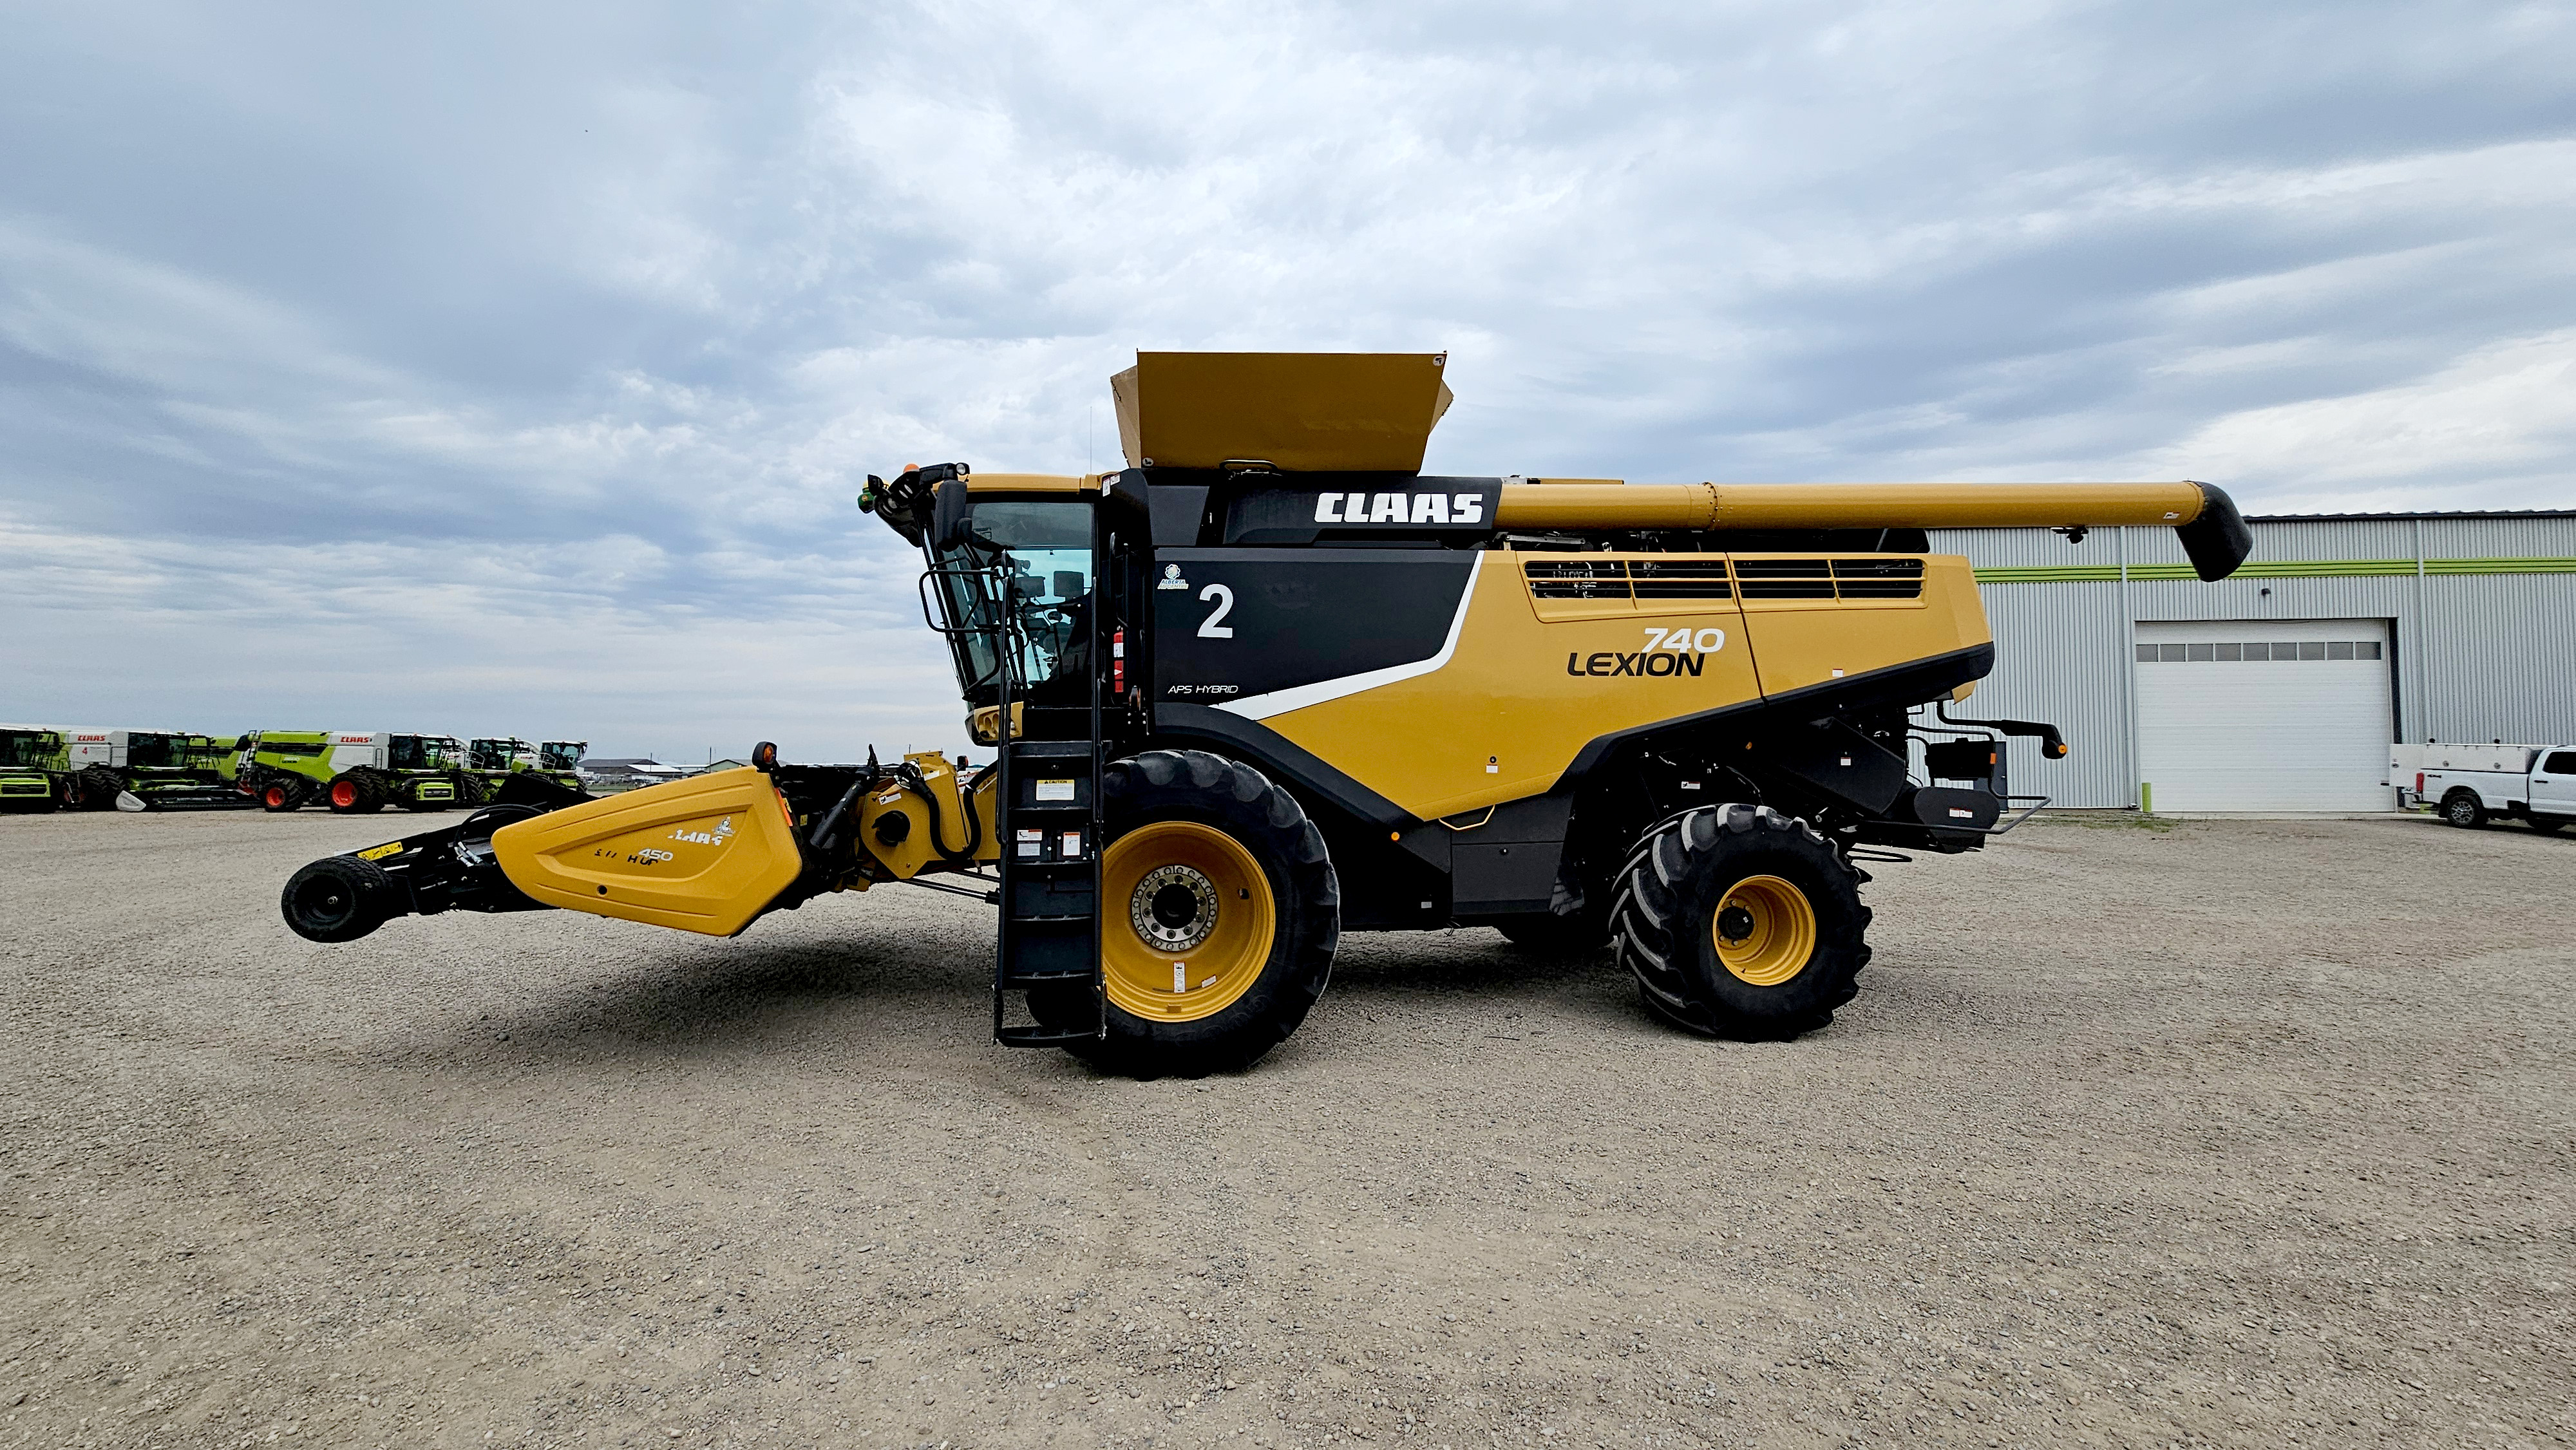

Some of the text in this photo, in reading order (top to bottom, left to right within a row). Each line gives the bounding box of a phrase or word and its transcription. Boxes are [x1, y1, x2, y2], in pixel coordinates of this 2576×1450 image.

[1314, 493, 1483, 523] CLAAS
[1197, 583, 1234, 638] 2
[1642, 628, 1725, 653] 740
[1567, 652, 1705, 677] LEXION
[1168, 685, 1238, 694] APS HYBRID
[638, 849, 674, 862] 450
